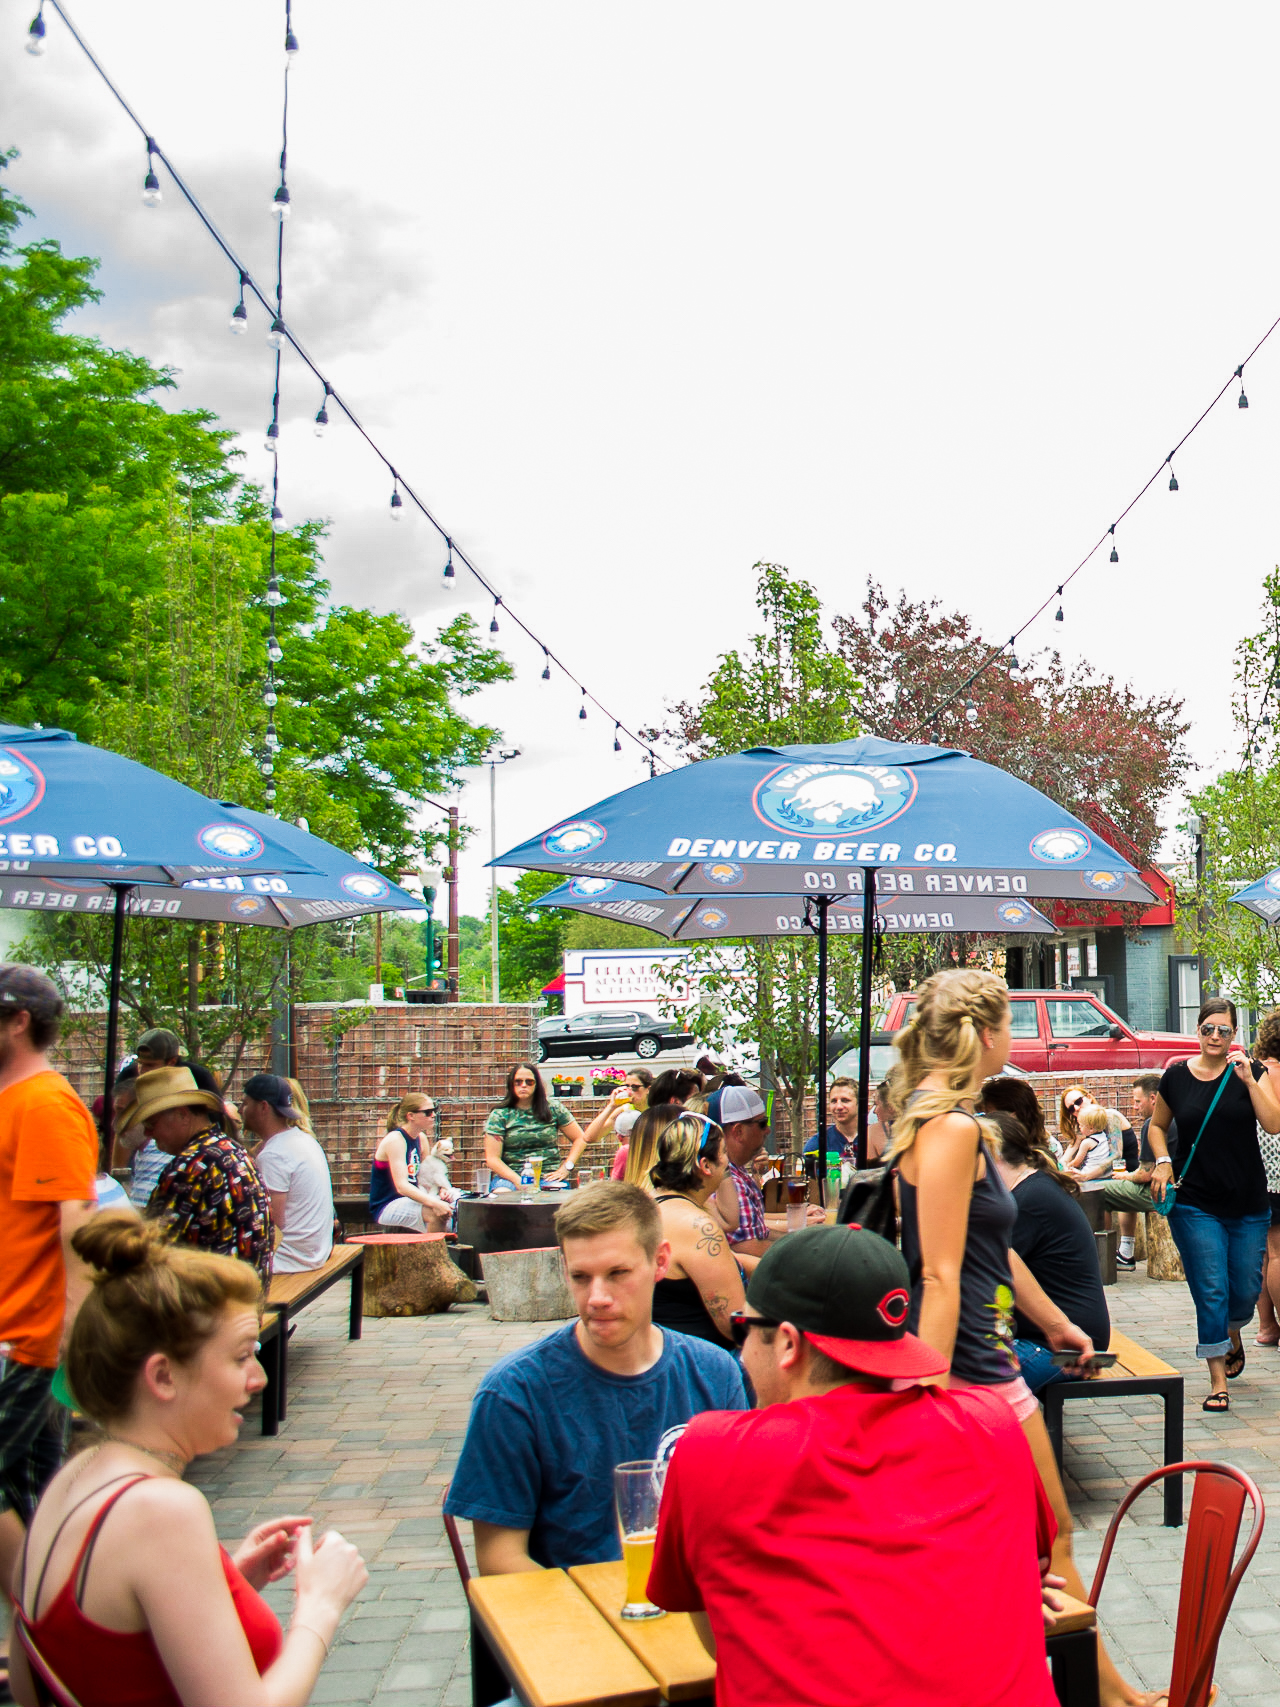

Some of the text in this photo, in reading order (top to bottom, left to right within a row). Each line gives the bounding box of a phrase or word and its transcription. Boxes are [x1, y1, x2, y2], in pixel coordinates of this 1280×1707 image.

[74, 835, 128, 858] CO.
[667, 837, 958, 862] DENVER BEER CO.
[252, 878, 292, 894] CO.
